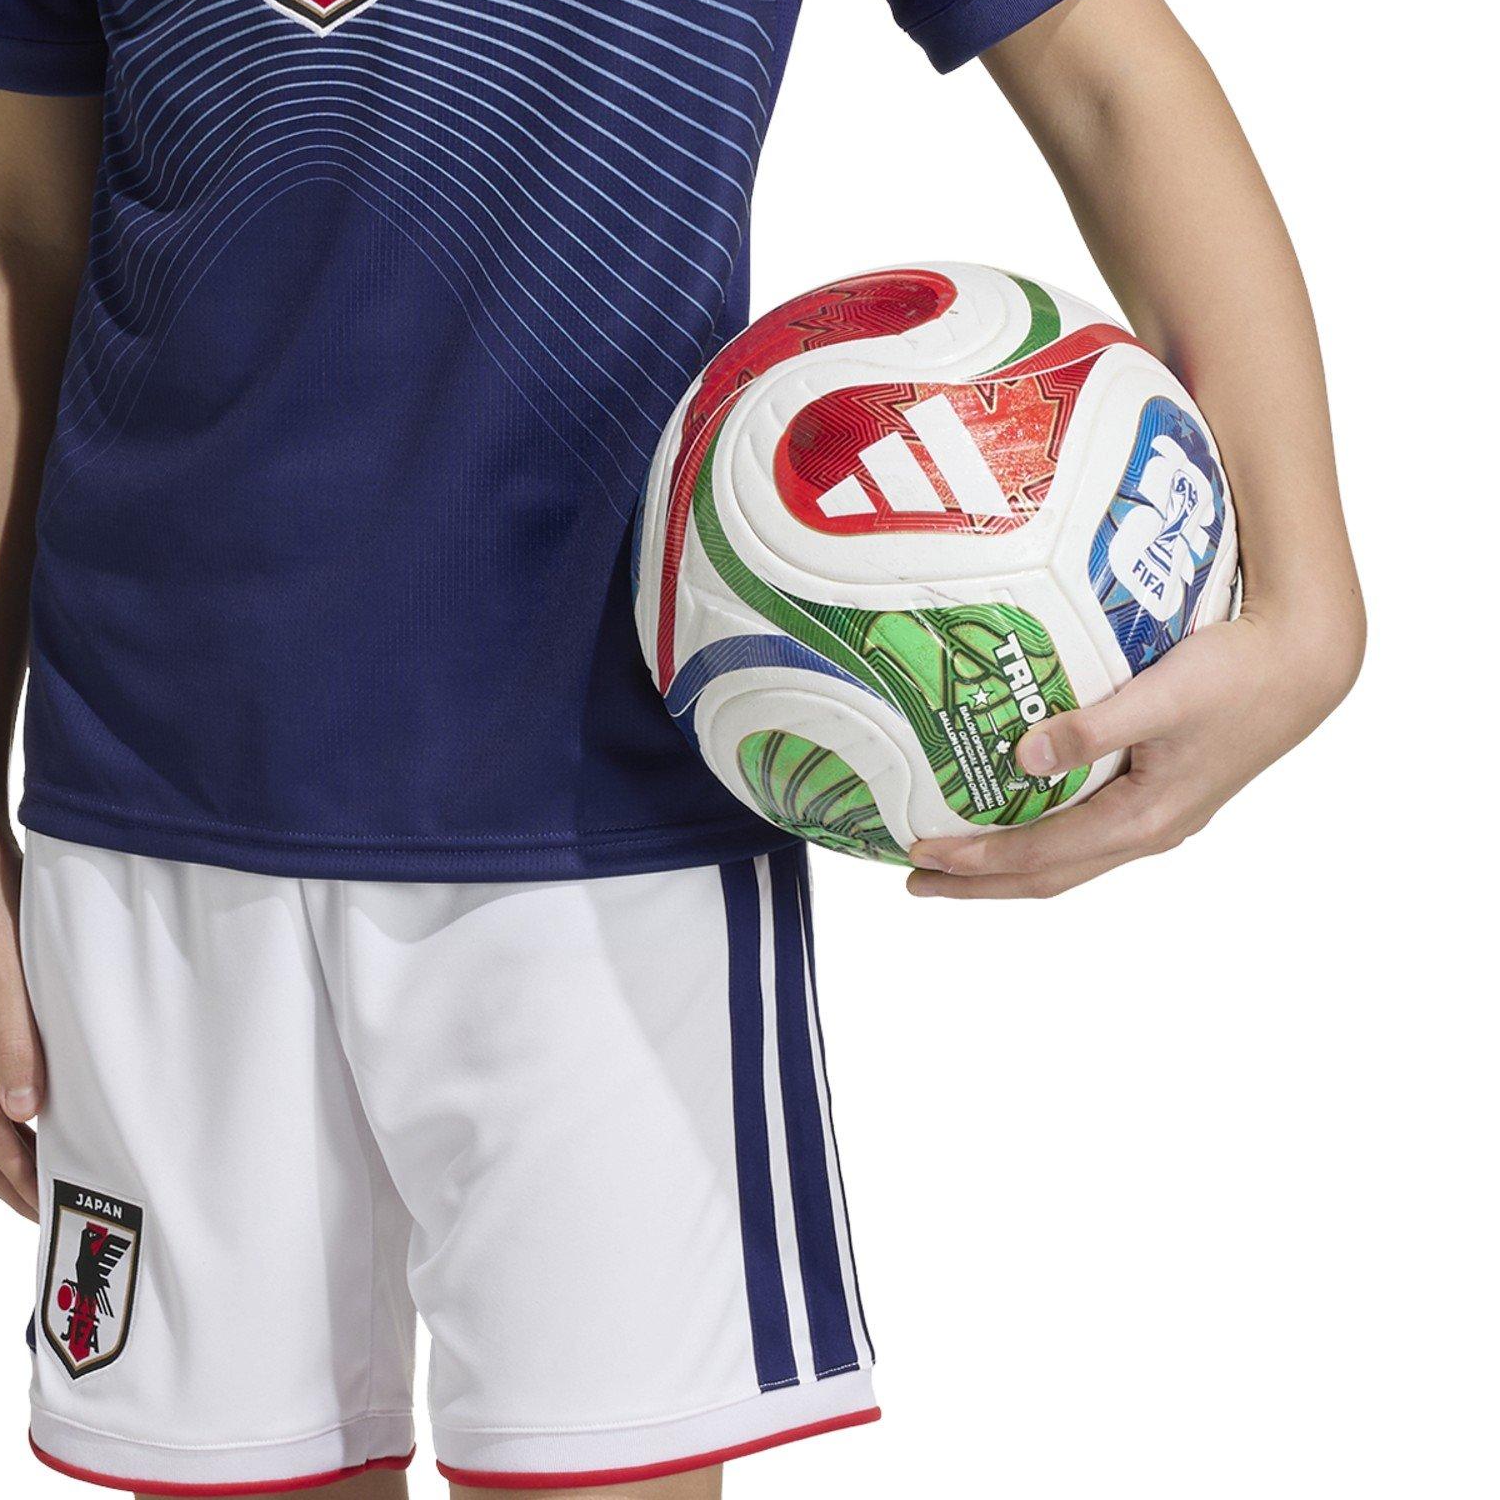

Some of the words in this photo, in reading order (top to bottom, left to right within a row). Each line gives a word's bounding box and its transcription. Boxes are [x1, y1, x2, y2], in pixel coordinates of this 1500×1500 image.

[1132, 558, 1166, 601] FIFA
[938, 710, 958, 745] BALLON
[957, 729, 978, 765] OFFICIAL
[972, 765, 989, 793] MATCH
[983, 764, 995, 779] DEL
[75, 1193, 122, 1220] JAPAN
[60, 1314, 100, 1354] JFA
